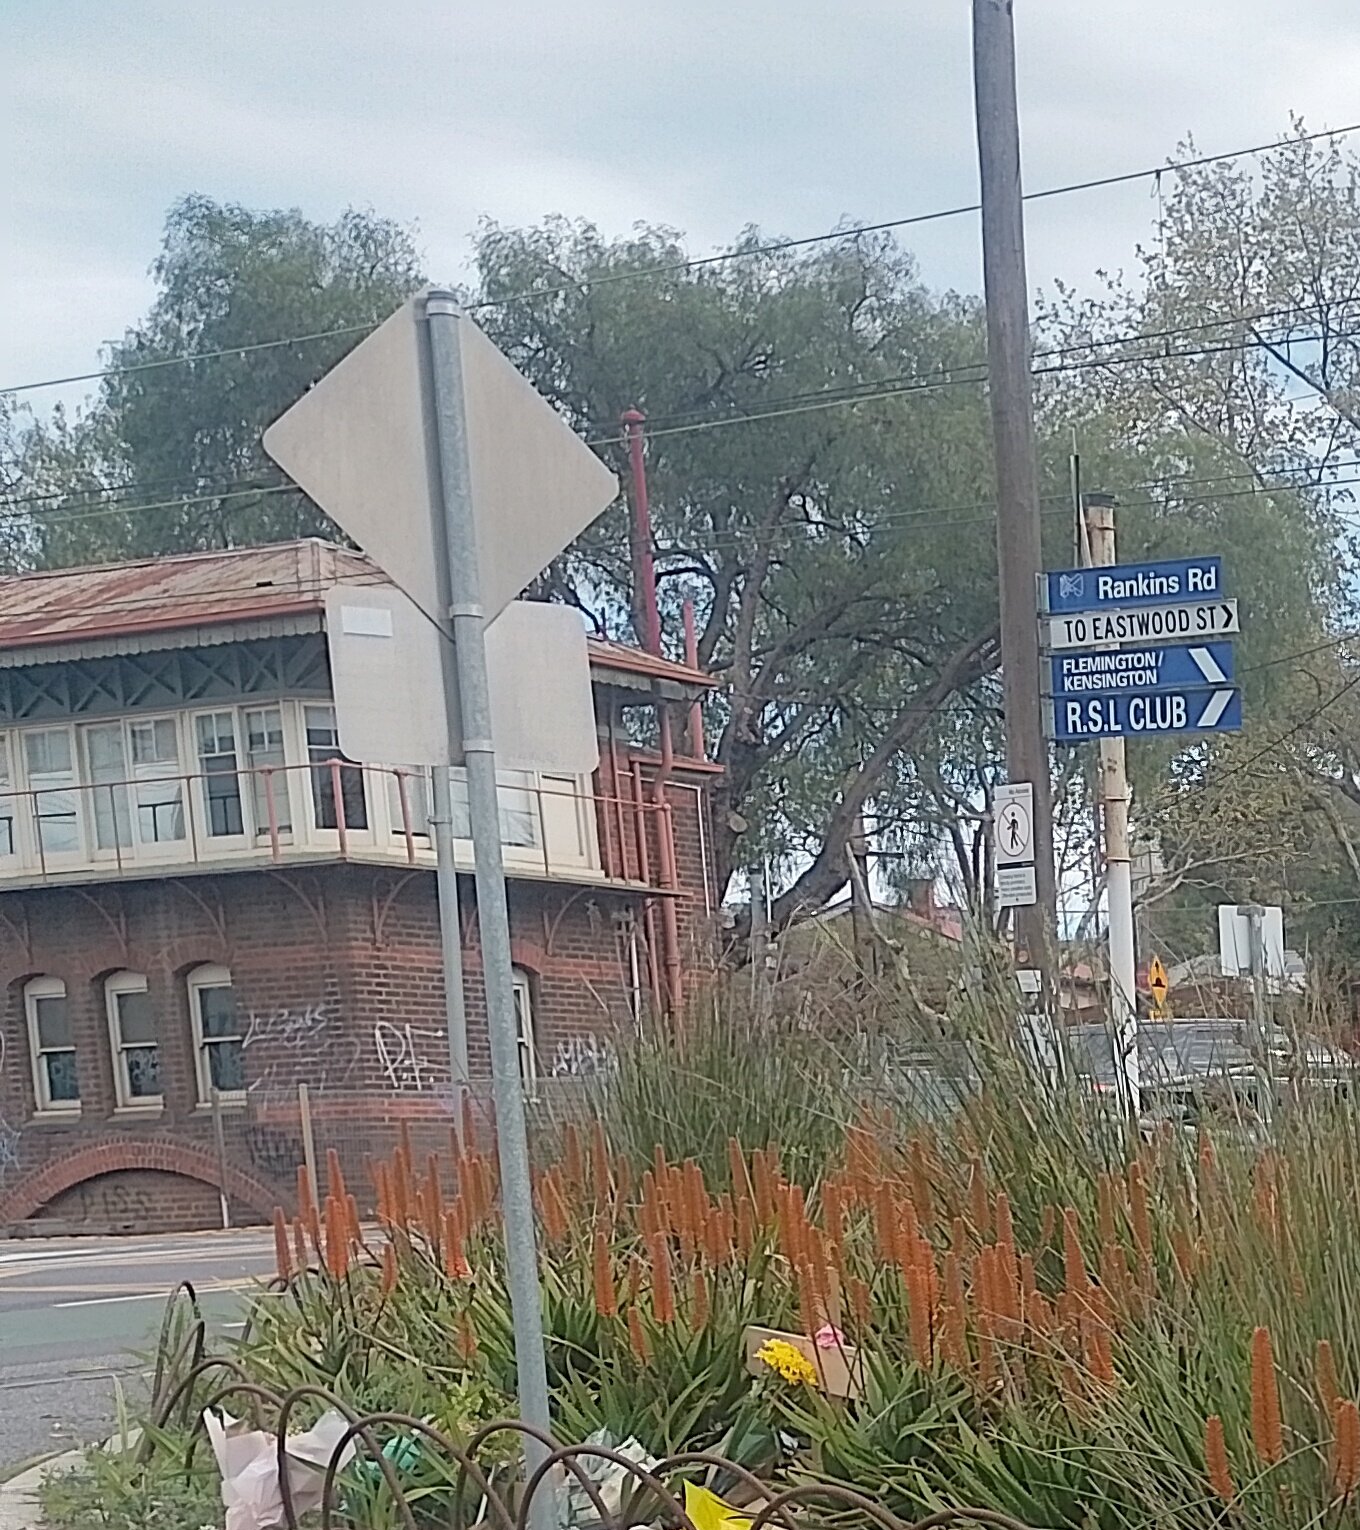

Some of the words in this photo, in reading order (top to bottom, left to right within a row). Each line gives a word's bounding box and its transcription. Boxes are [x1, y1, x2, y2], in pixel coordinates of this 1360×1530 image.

[1098, 572, 1180, 600] Rankins
[1187, 566, 1217, 592] Rd
[1064, 619, 1087, 643] TO
[1093, 609, 1191, 640] EASTWOOD
[1196, 606, 1217, 630] ST
[1064, 669, 1158, 692] KENSINGTON
[1067, 698, 1122, 733] R.S.L
[1128, 696, 1187, 731] CLUB
